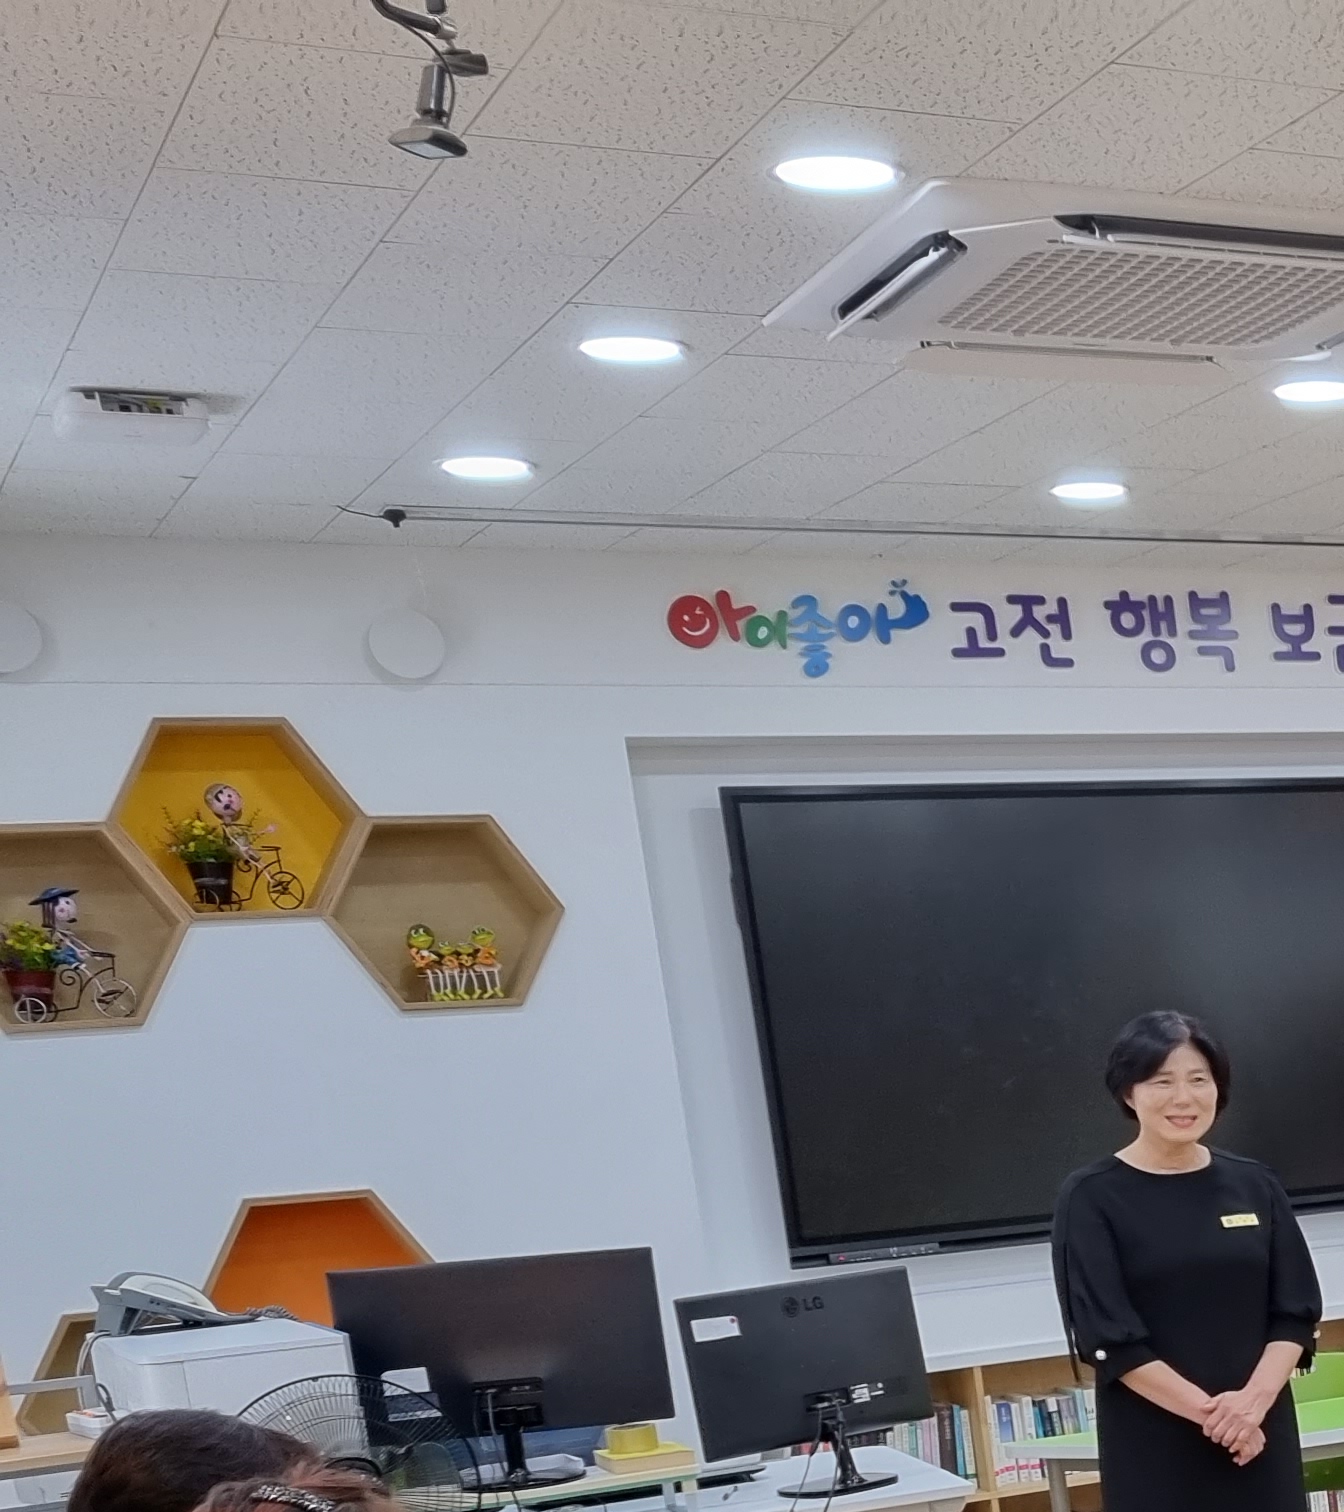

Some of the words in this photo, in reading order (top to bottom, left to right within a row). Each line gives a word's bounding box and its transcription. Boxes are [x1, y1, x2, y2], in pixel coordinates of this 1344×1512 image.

[667, 579, 930, 678] 아이좋아
[949, 594, 1076, 669] 고전
[1104, 590, 1240, 673] 행복
